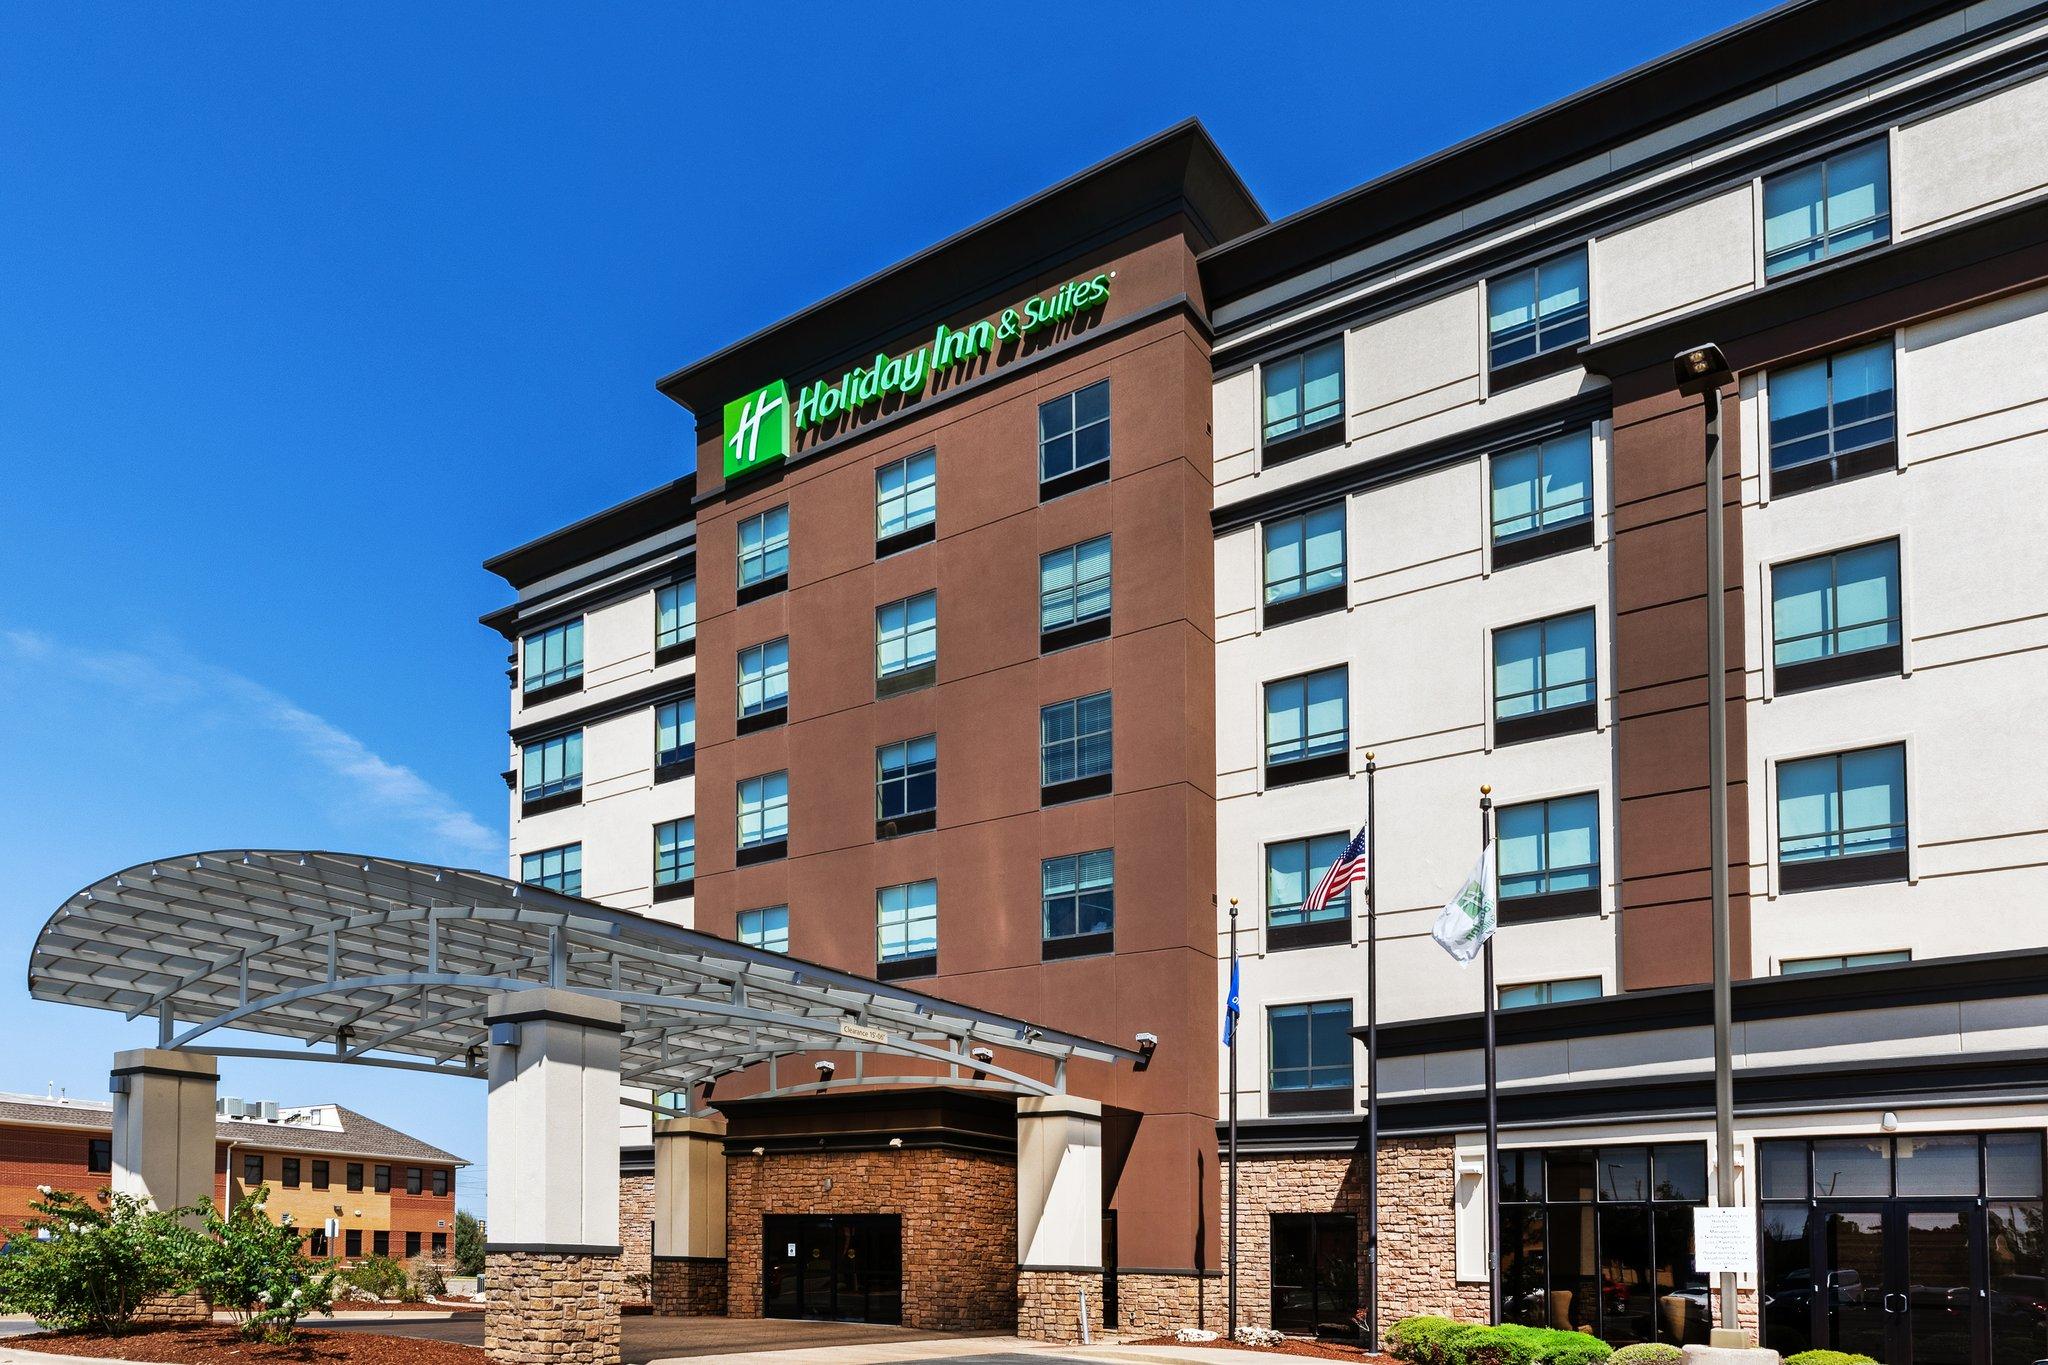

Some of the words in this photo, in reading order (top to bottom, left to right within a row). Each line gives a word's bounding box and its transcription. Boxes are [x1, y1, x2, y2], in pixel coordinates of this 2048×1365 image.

[794, 347, 928, 429] Holiday
[931, 320, 995, 371] Inn
[997, 308, 1020, 340] &
[1021, 273, 1109, 331] Suites
[843, 1025, 868, 1038] Clearance
